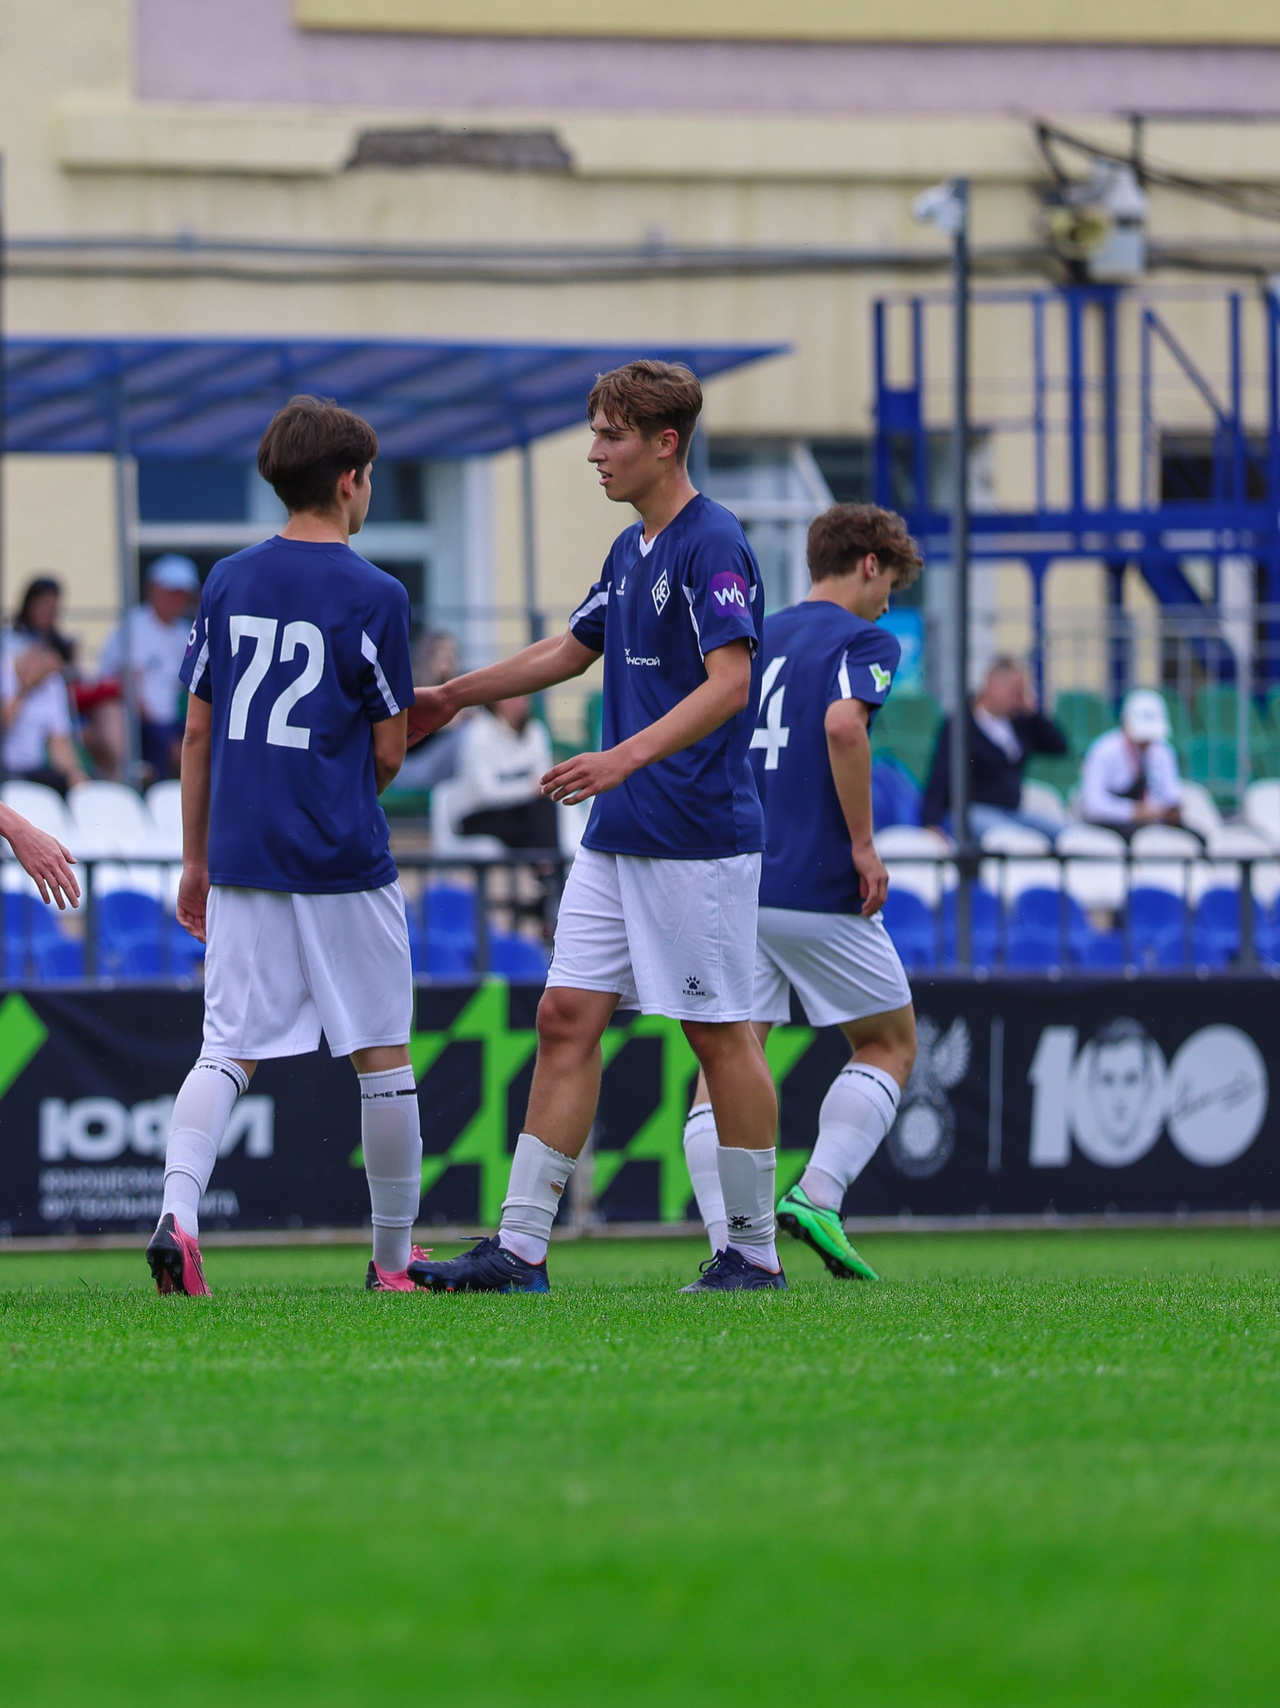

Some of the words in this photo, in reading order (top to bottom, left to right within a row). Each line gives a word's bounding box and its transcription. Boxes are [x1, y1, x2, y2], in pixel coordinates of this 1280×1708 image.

[228, 614, 325, 750] 72
[749, 656, 790, 770] 4
[682, 989, 706, 997] KELME
